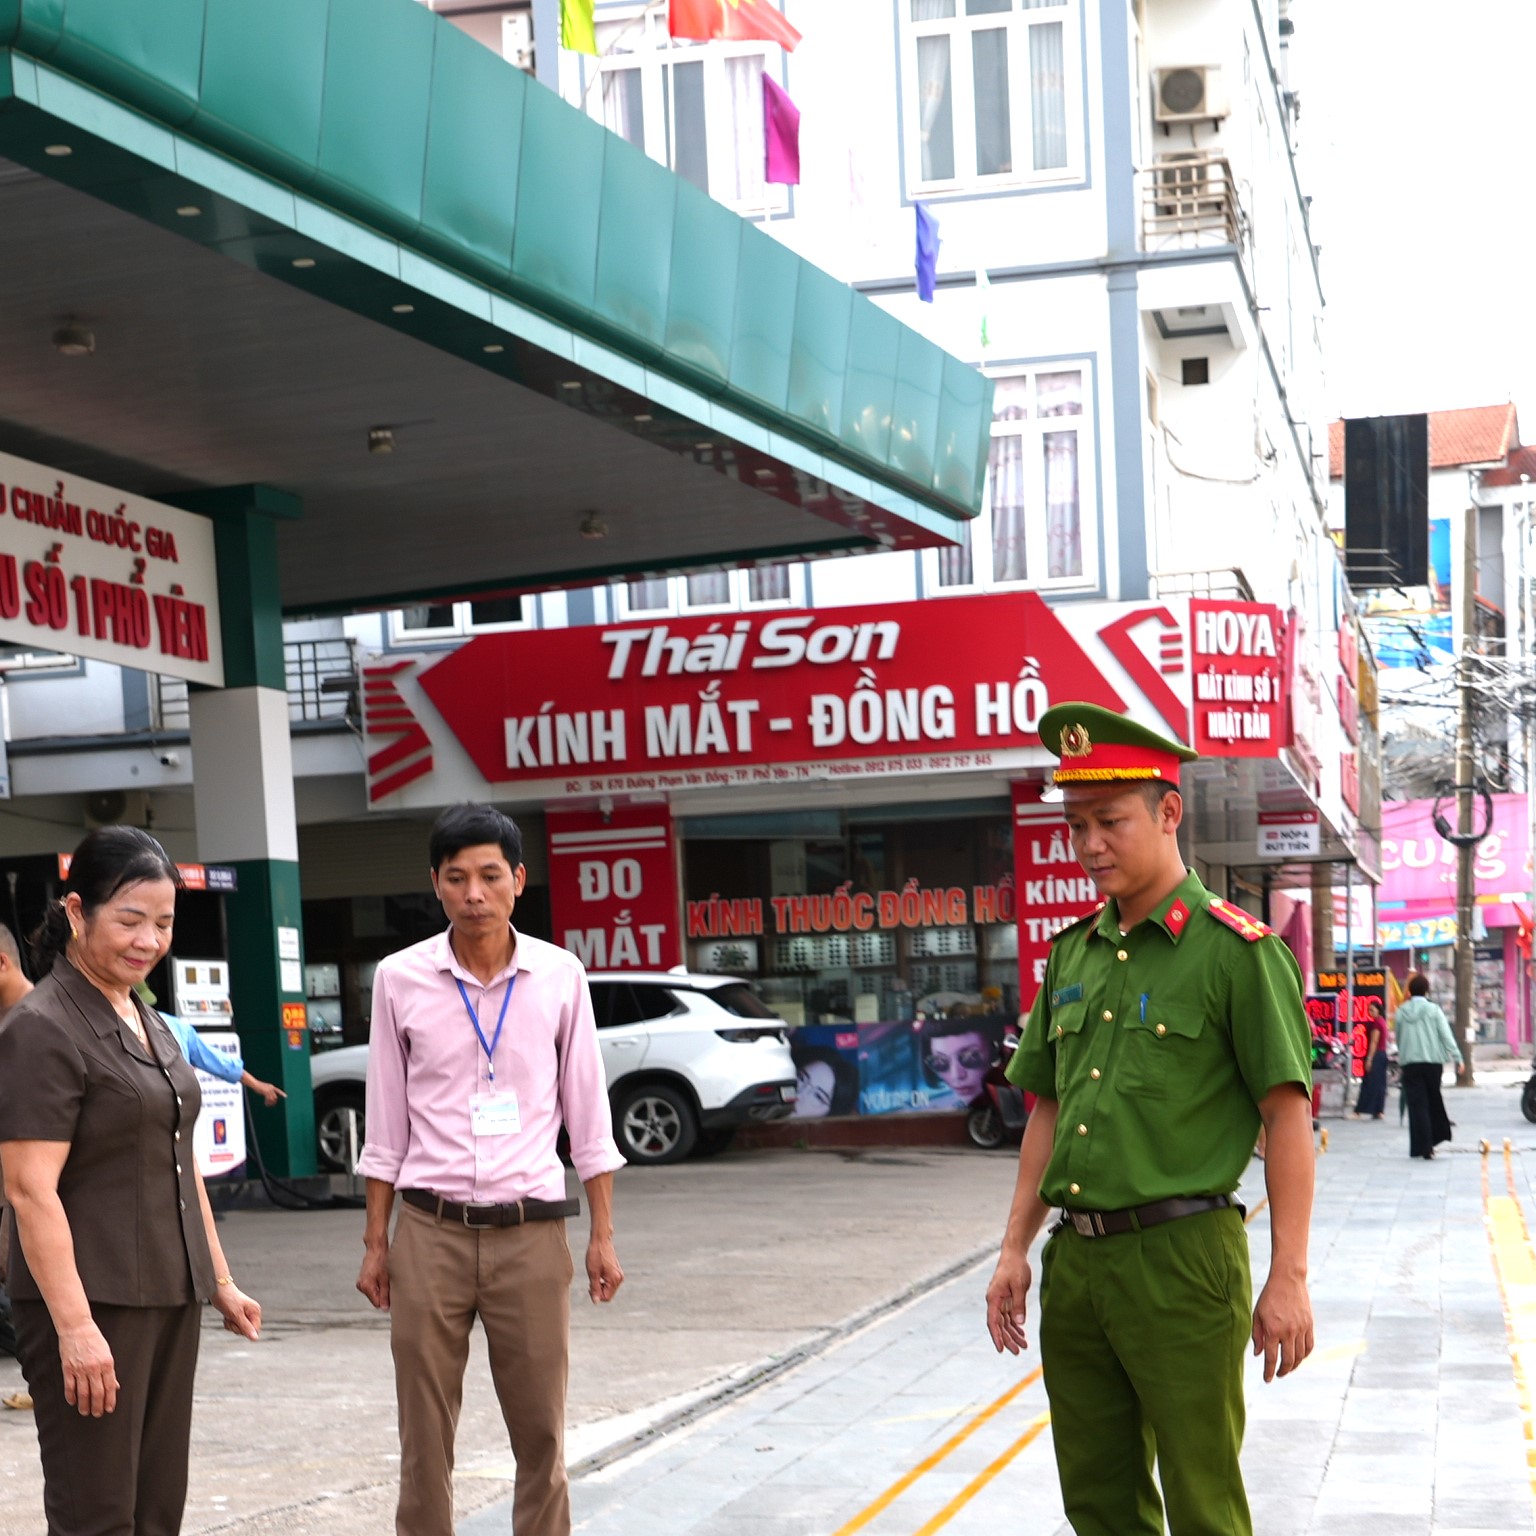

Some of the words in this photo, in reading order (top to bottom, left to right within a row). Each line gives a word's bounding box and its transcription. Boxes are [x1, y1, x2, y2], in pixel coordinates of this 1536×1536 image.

[11, 480, 83, 537] CHUẨN
[86, 502, 142, 552] QUỐC
[146, 525, 179, 563] GIA
[23, 542, 68, 630] SỐ
[70, 574, 91, 636] 1
[90, 557, 151, 649] PHỔ
[152, 584, 209, 662] YÊN
[601, 619, 752, 681] Thái
[752, 617, 901, 670] Sơn
[1195, 610, 1277, 658] HOYA
[504, 701, 628, 769] KÍNH
[645, 680, 760, 759] MẮT
[808, 666, 955, 748] ĐỒNG
[975, 655, 1050, 737] HỒ
[1197, 663, 1223, 700] MẮT
[1224, 669, 1254, 701] KÍNH
[1254, 667, 1271, 703] SỐ
[1273, 677, 1279, 703] 1
[1207, 705, 1242, 744] NHẬT
[1243, 703, 1271, 739] BẢN
[578, 857, 643, 902] ĐO
[687, 892, 763, 938] KÍNH
[770, 880, 874, 935] THUỐC
[877, 876, 968, 929] ĐỒNG
[973, 871, 1017, 924] HỒ
[1025, 873, 1098, 905] KÍNH
[564, 910, 666, 970] MẮT
